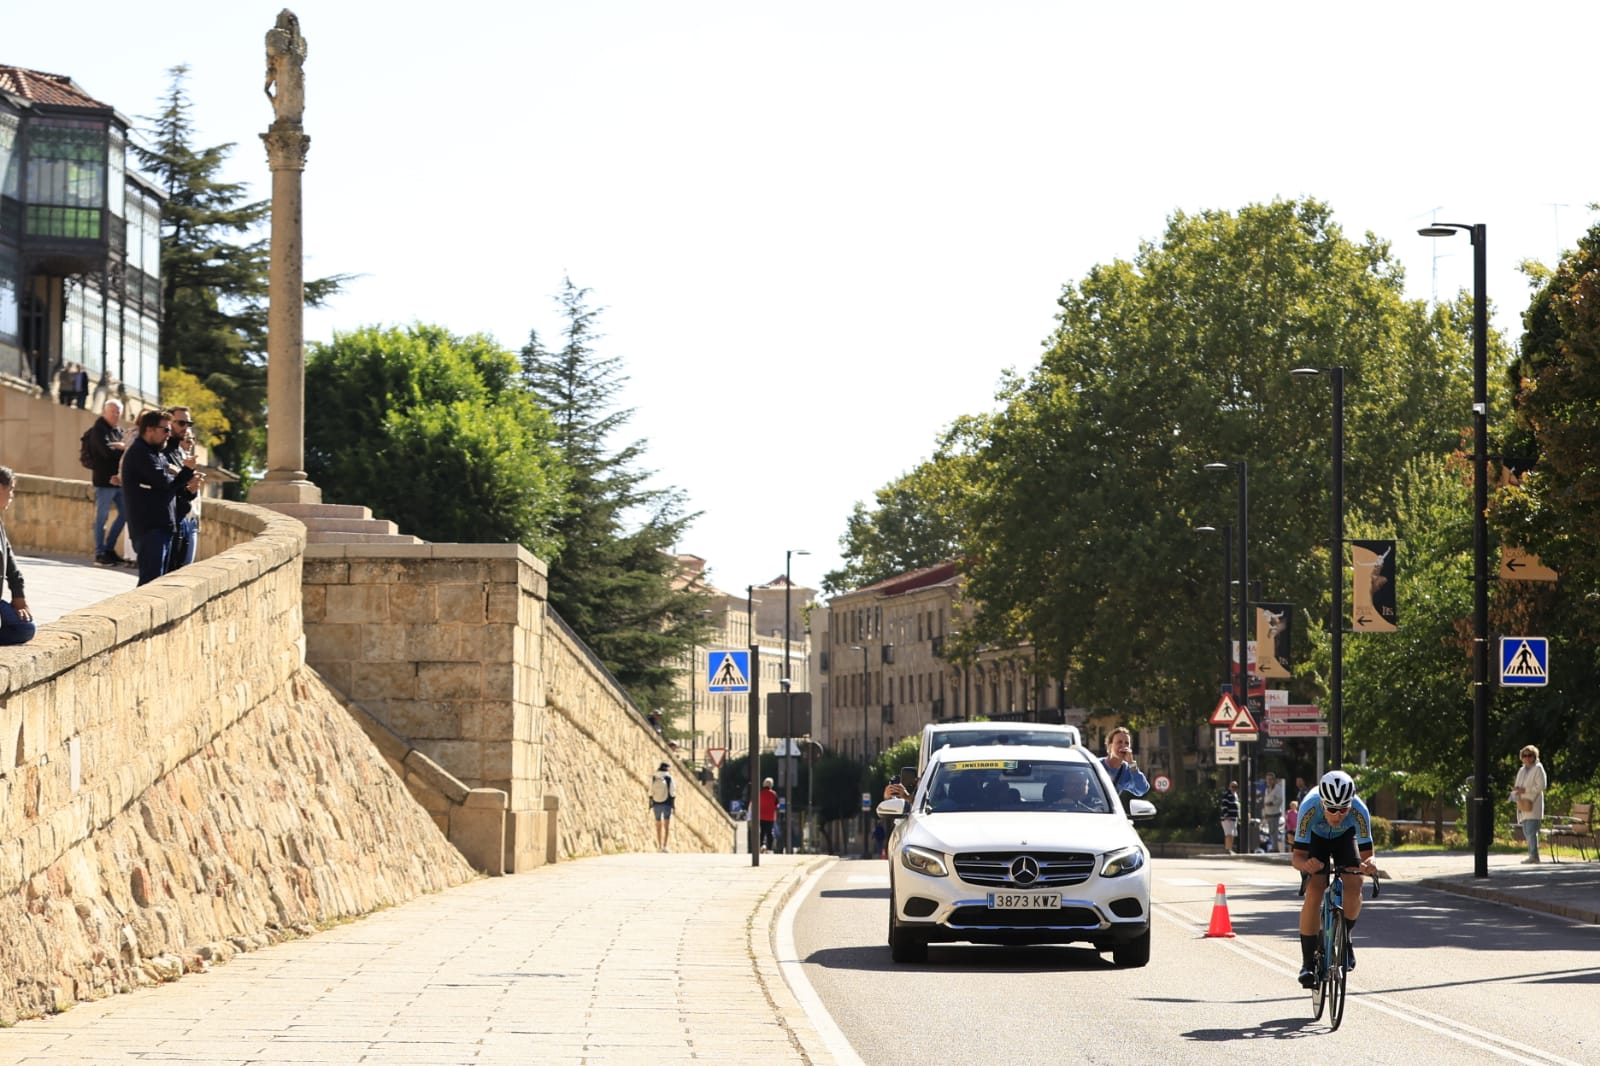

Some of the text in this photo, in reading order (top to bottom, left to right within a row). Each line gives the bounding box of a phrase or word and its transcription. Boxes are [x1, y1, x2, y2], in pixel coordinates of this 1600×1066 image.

[1157, 779, 1168, 787] 30
[731, 802, 739, 810] P
[996, 895, 1058, 907] 3873 KWZ
